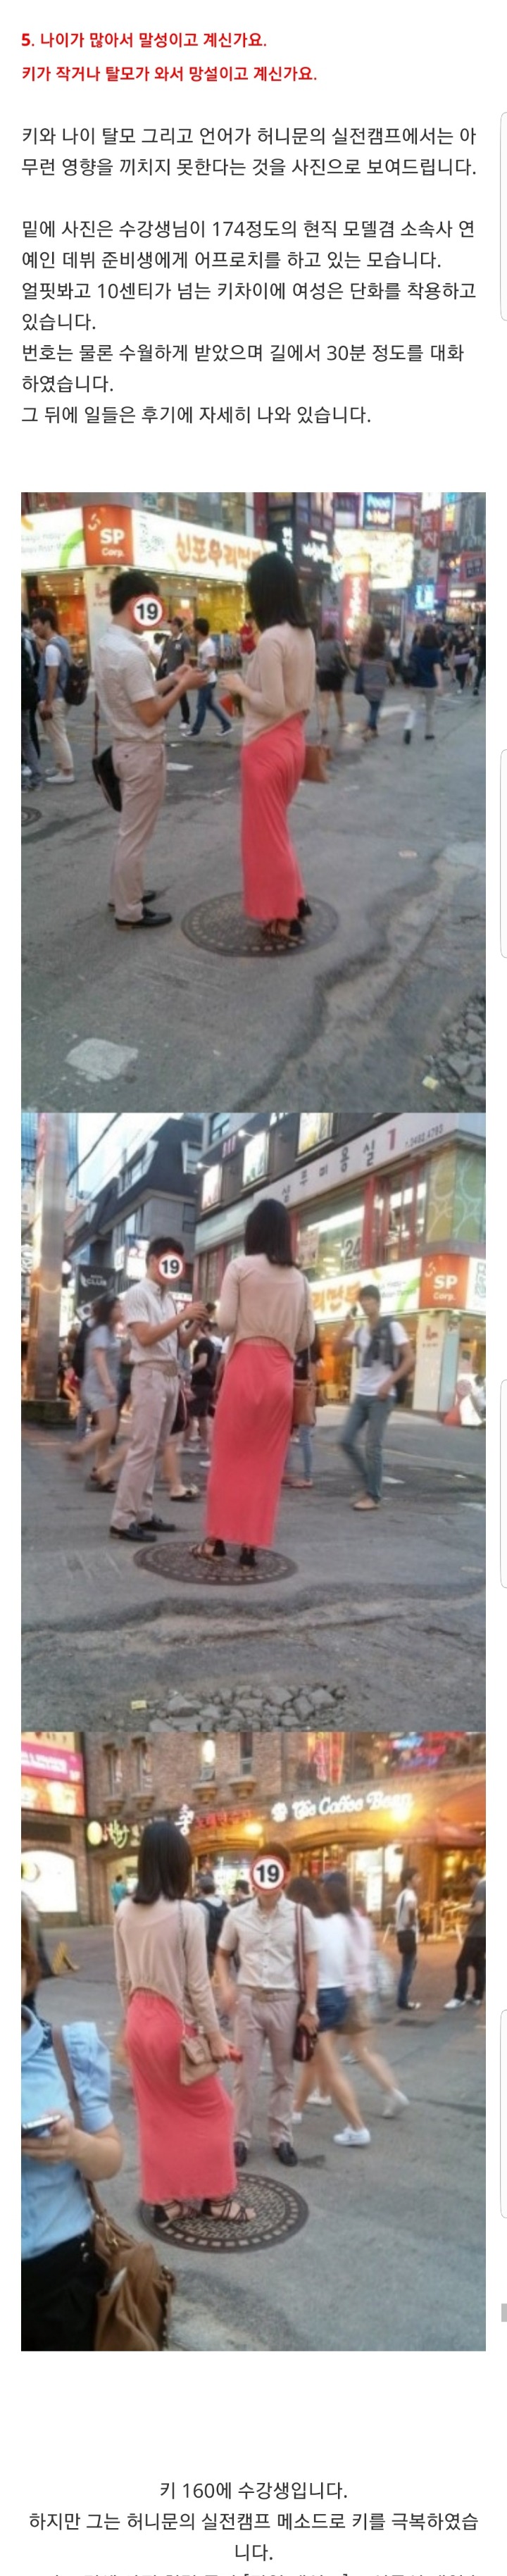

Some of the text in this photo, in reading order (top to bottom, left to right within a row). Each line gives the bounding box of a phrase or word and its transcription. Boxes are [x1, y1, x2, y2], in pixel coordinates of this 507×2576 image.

[100, 528, 125, 544] SP
[101, 547, 125, 558] Corp.
[344, 1237, 361, 1260] 24
[433, 1275, 458, 1289] SP
[433, 1292, 457, 1302] Corp.
[319, 1794, 364, 1815] Coffee
